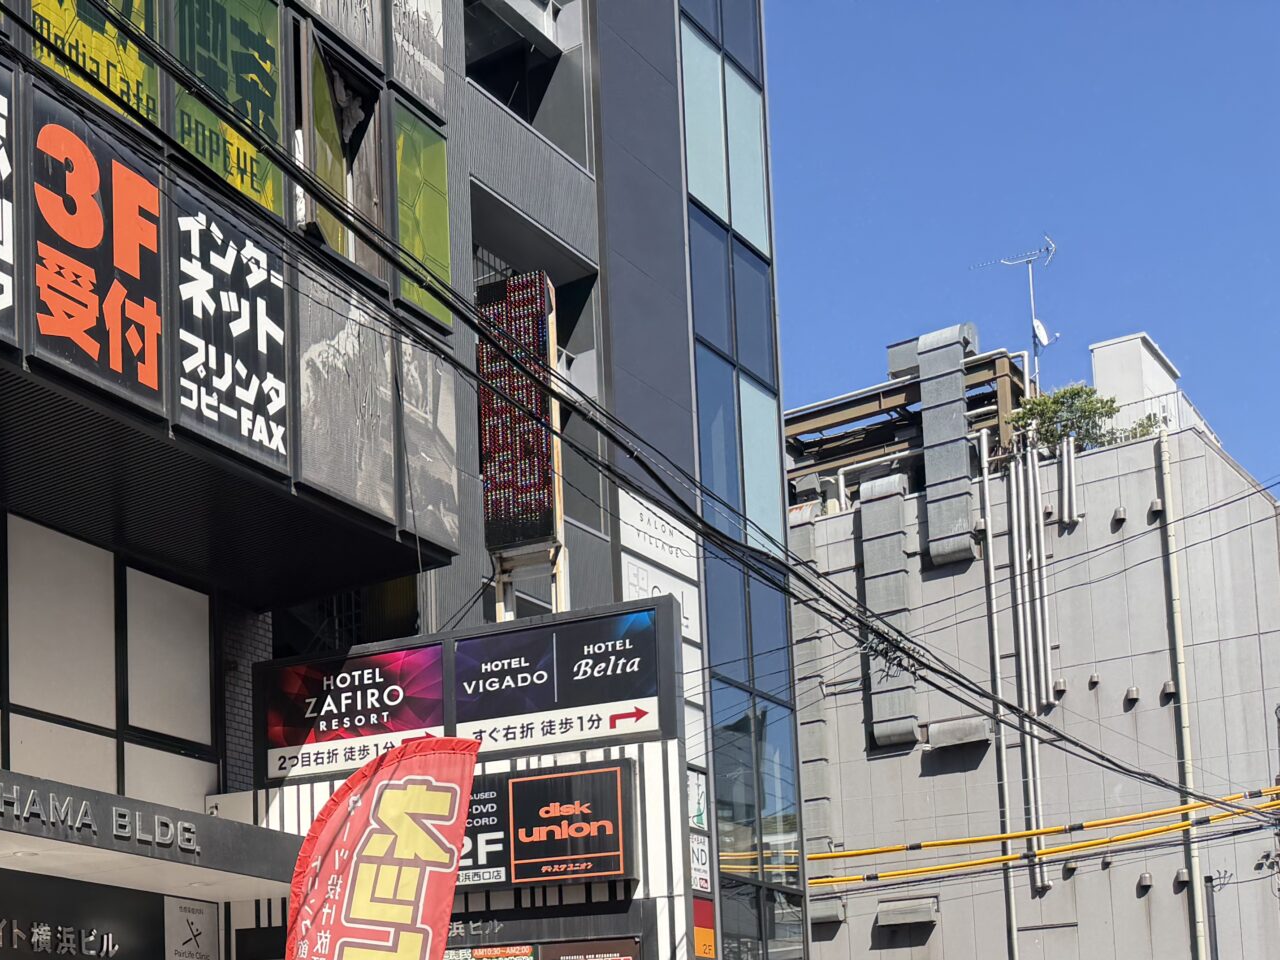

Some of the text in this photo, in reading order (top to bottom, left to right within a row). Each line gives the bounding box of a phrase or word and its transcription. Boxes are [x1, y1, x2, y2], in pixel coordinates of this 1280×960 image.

[180, 109, 261, 194] POPEYE
[33, 124, 160, 280] 3F
[35, 240, 162, 391] 受付
[178, 257, 285, 353] ネット
[179, 328, 286, 415] プリンタ
[639, 512, 675, 538] SALON
[636, 529, 680, 559] VILLAGE
[583, 639, 634, 656] HOTEL
[481, 656, 531, 673] HOTEL
[572, 655, 641, 682] Belta
[323, 667, 385, 690] HOTEL
[462, 670, 549, 695] VIGADO
[304, 684, 405, 718] ZAFIRO
[319, 711, 391, 732] RESORT
[471, 713, 604, 743] すぐ右折 徒歩1分
[277, 751, 339, 771] 2つ目右折
[465, 816, 498, 827] CORD
[538, 800, 593, 819] disk
[112, 806, 202, 857] BLDG.
[518, 819, 615, 843] union
[459, 831, 505, 867] 2F
[541, 860, 593, 873] ディスクユニオン
[195, 951, 211, 960] Clinic
[702, 943, 713, 955] 2F
